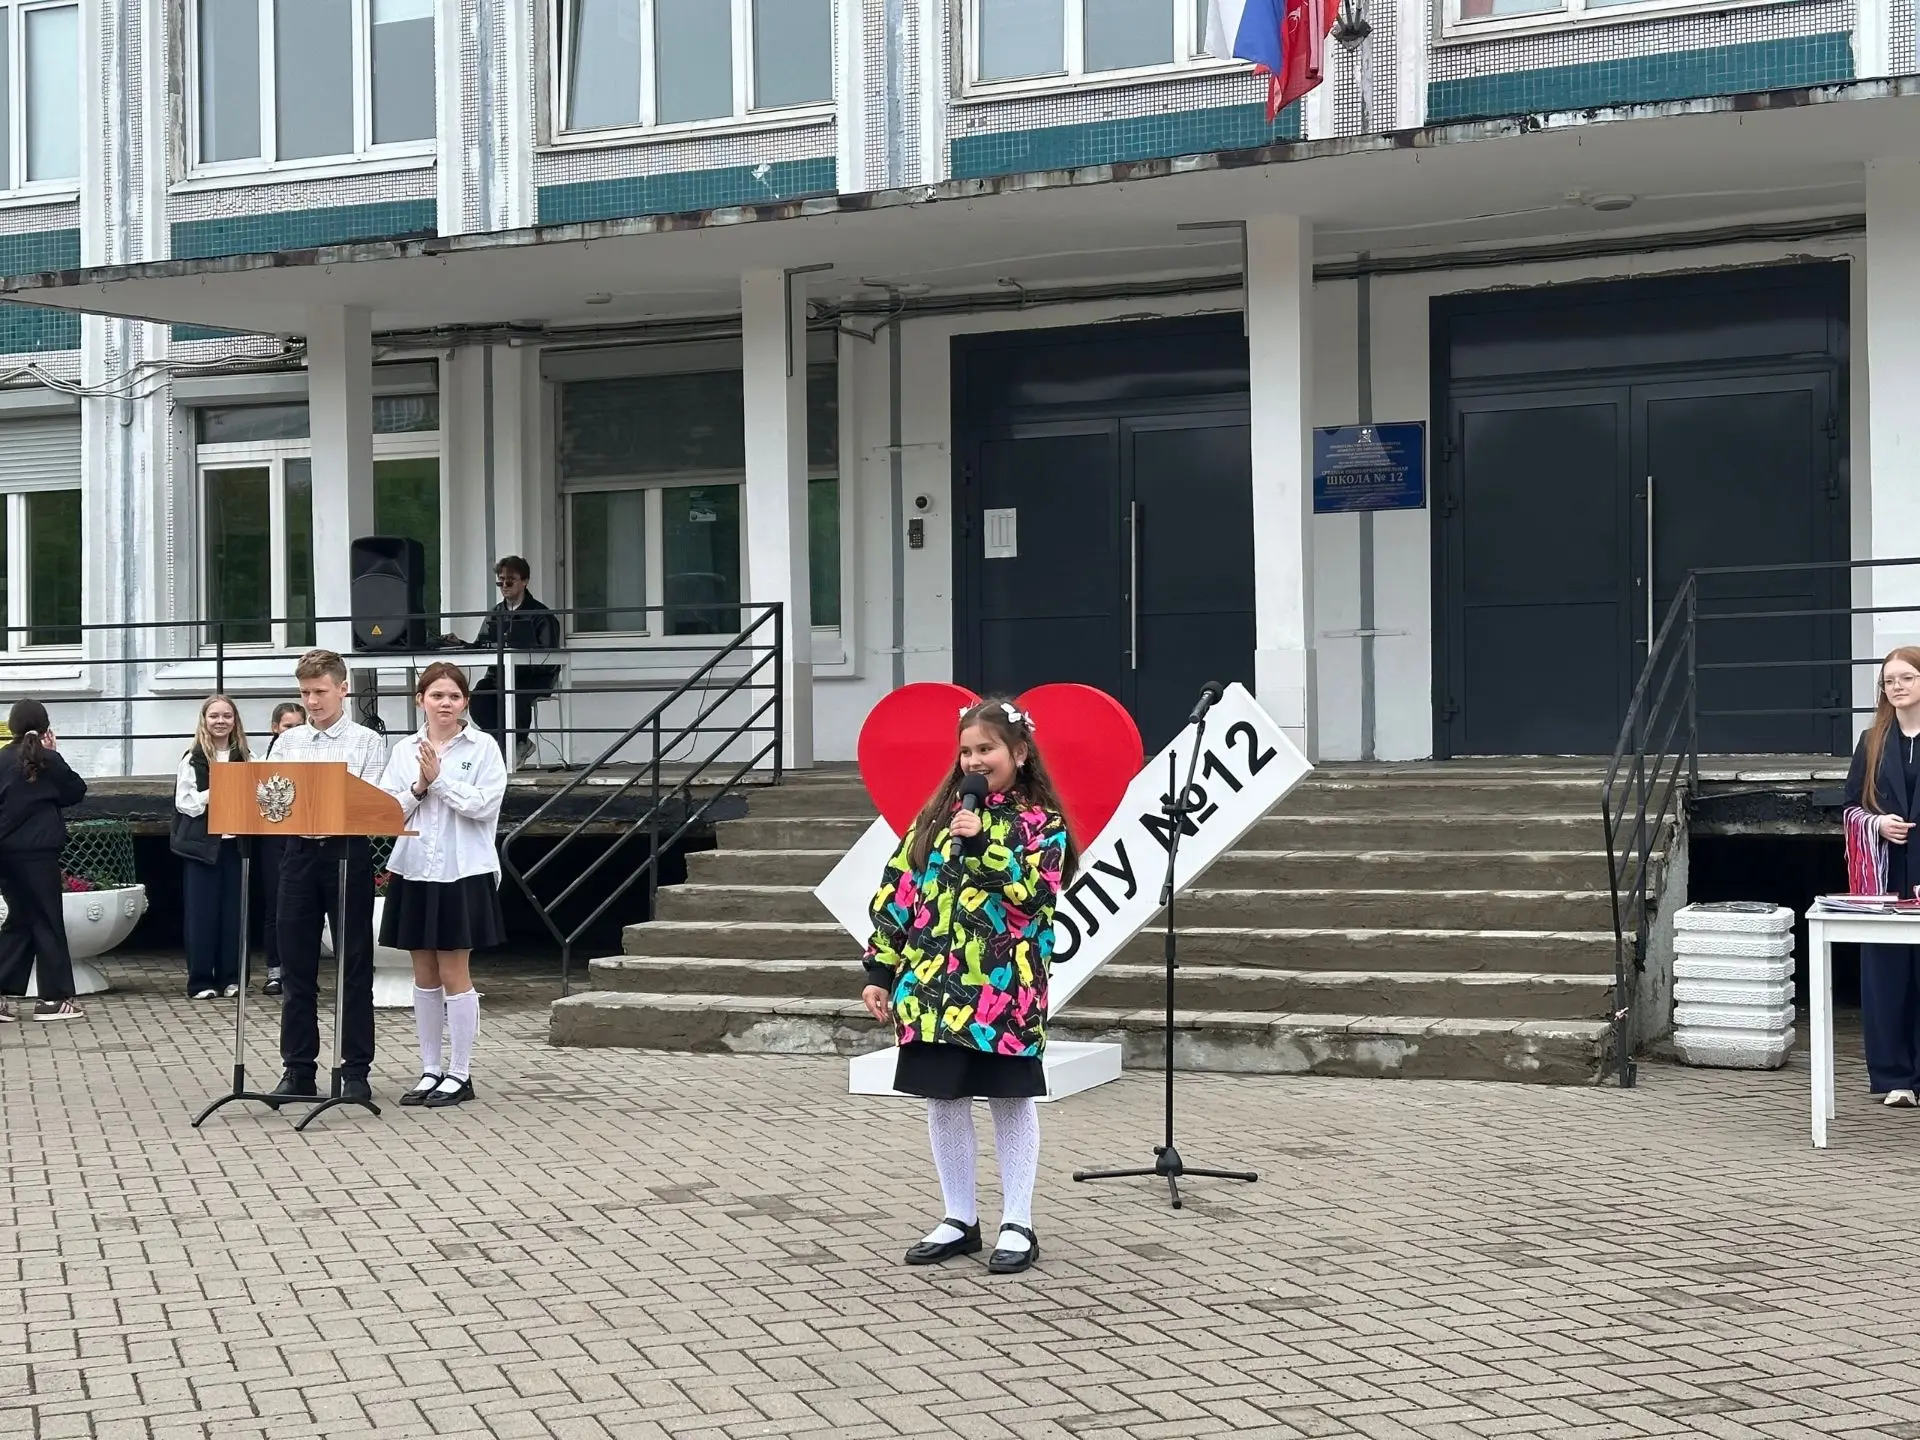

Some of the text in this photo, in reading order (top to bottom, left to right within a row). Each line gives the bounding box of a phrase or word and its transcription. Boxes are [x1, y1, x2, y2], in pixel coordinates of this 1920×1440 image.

[1326, 474, 1371, 485] ШКОЛА
[1389, 472, 1404, 482] 12
[461, 761, 472, 771] SF
[1048, 838, 1137, 979] ОЛУ
